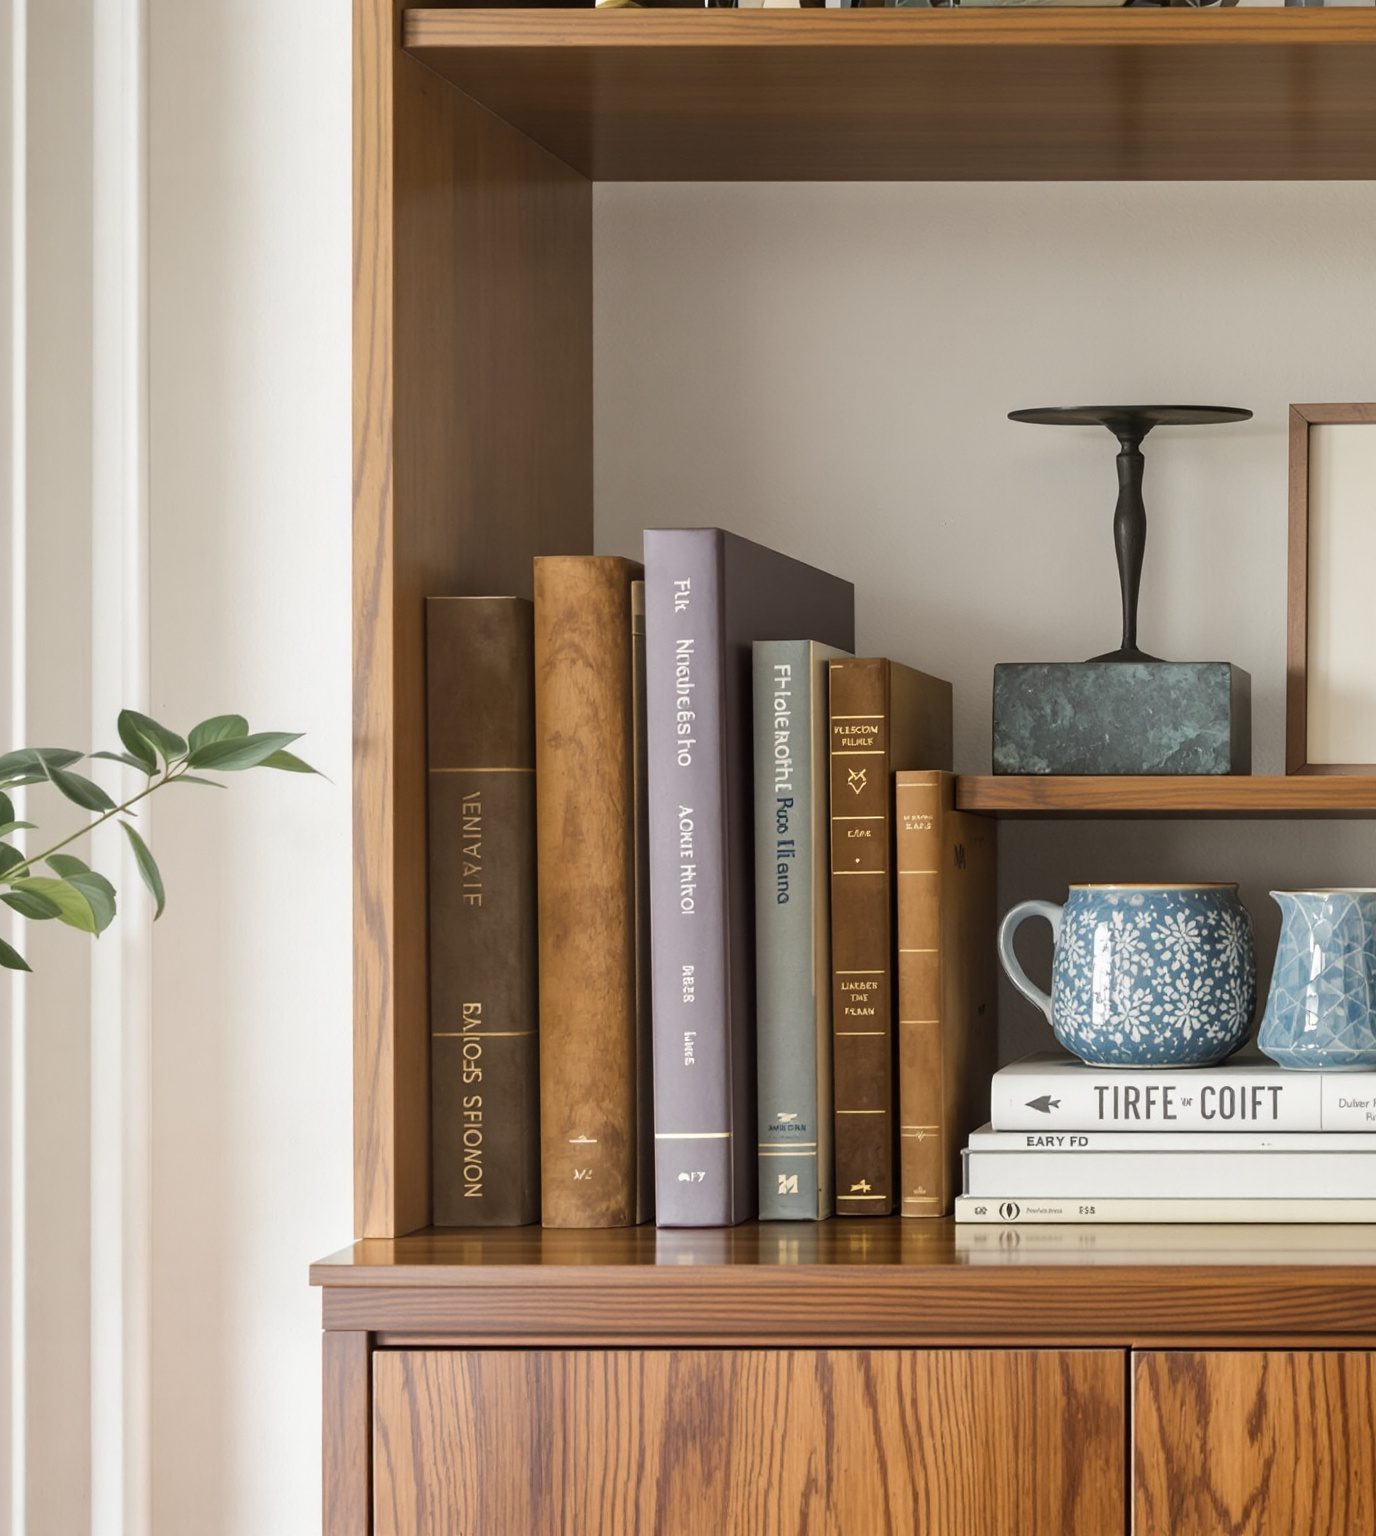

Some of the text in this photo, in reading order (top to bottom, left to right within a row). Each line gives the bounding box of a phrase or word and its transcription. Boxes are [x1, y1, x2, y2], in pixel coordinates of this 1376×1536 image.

[1093, 1085, 1284, 1121] TIRFE COIFT
[1026, 1136, 1089, 1148] EARY FD
